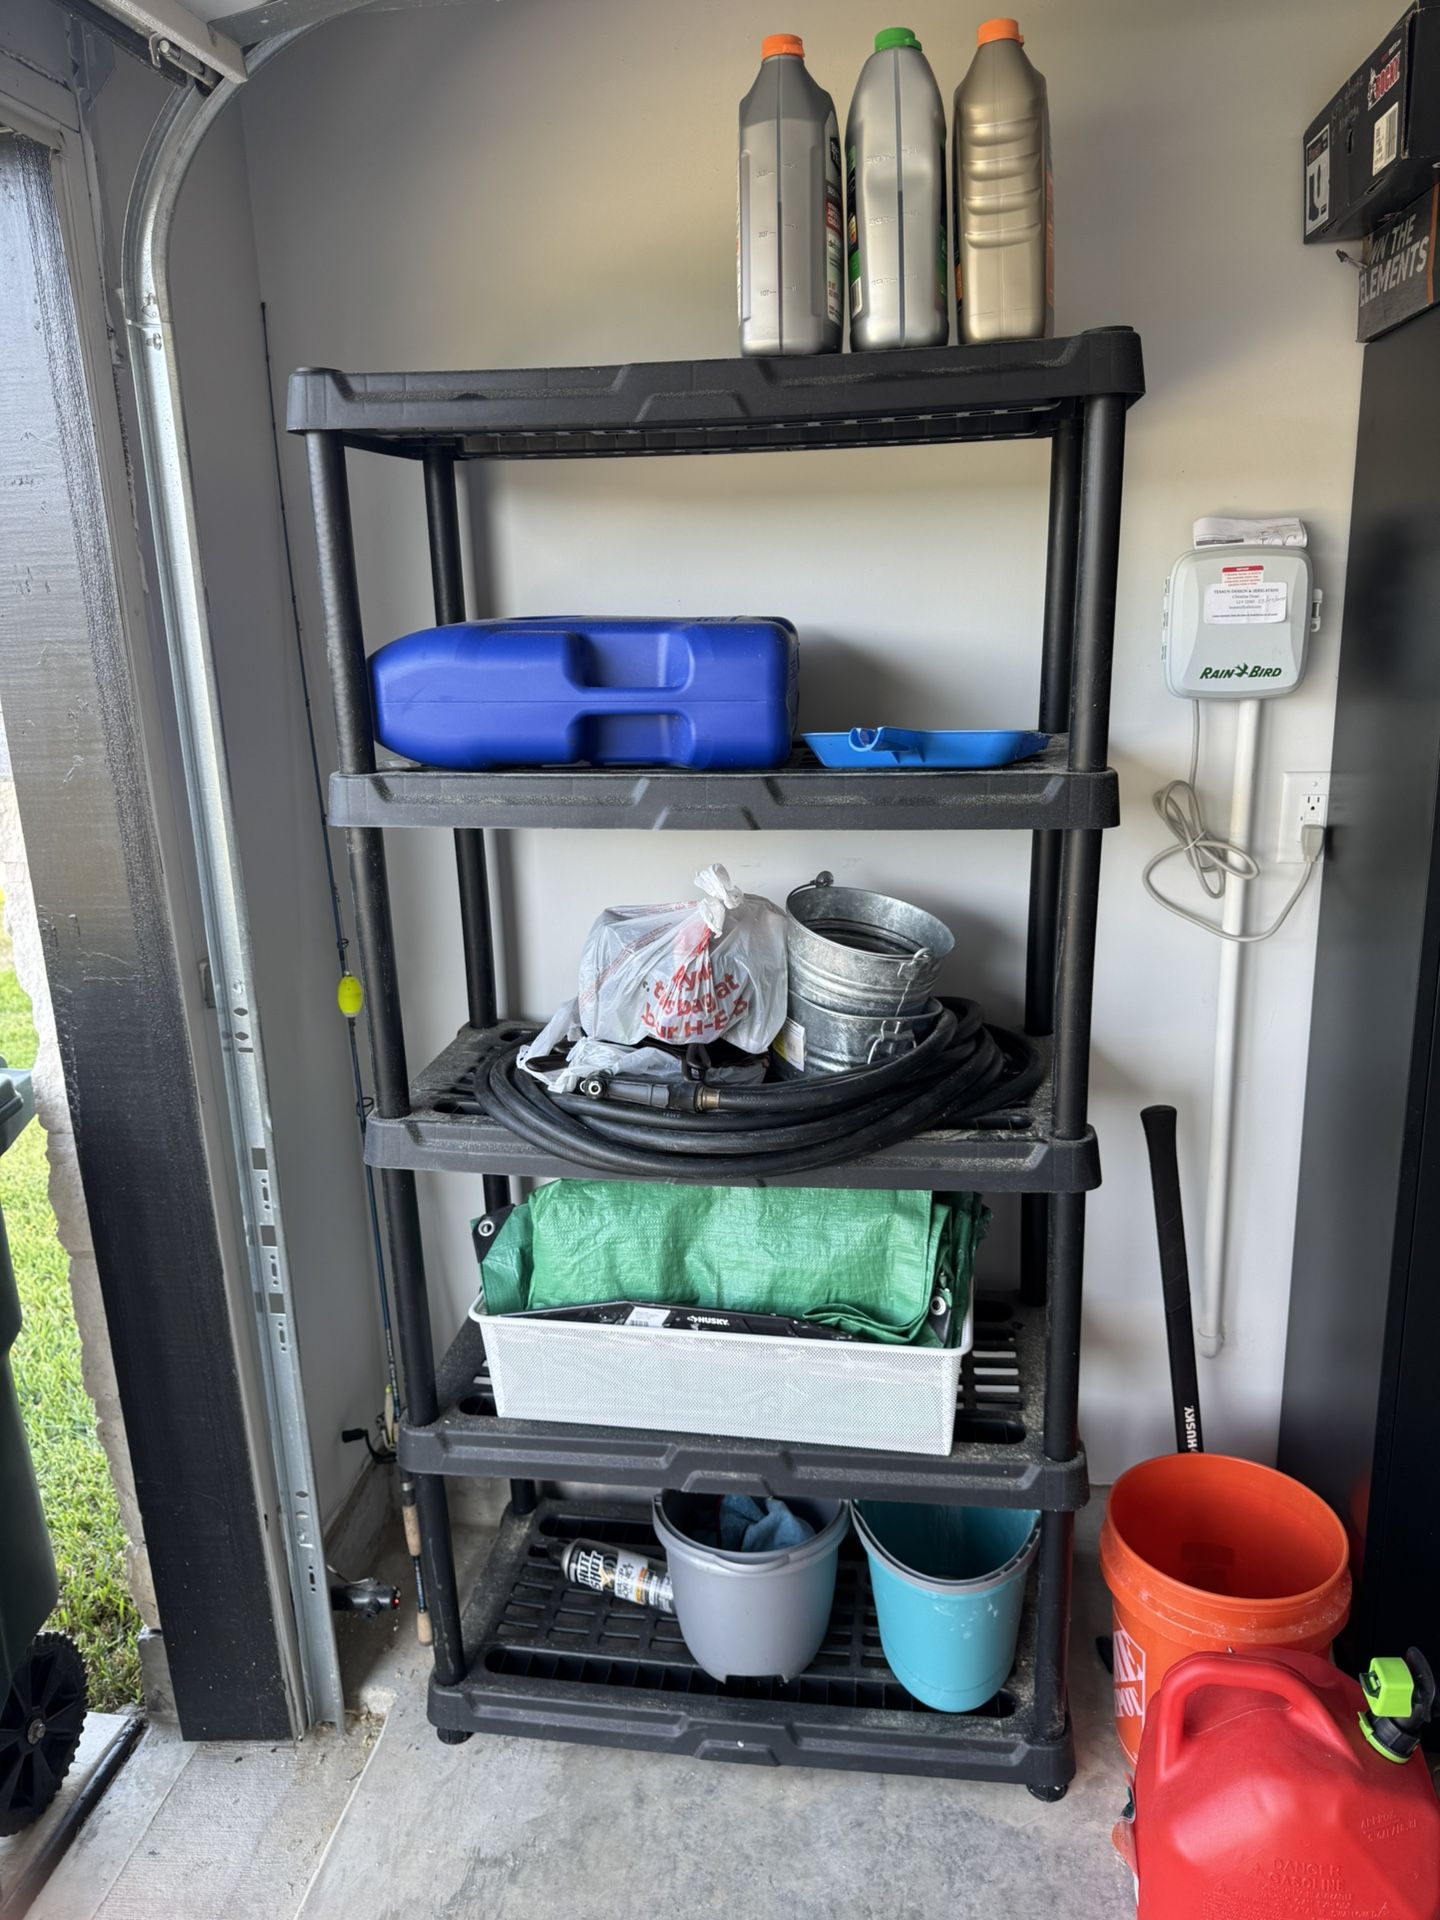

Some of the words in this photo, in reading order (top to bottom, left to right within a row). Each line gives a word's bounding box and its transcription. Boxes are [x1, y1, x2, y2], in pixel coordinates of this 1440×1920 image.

[1391, 213, 1417, 255] THE
[1360, 236, 1430, 307] ELEMENTS
[1200, 666, 1236, 679] RAIN
[1248, 665, 1282, 677] BIRD
[714, 973, 740, 1000] at
[684, 998, 749, 1037] H-EB
[698, 1315, 729, 1326] HUSKY
[1183, 1405, 1198, 1448] HUSKY
